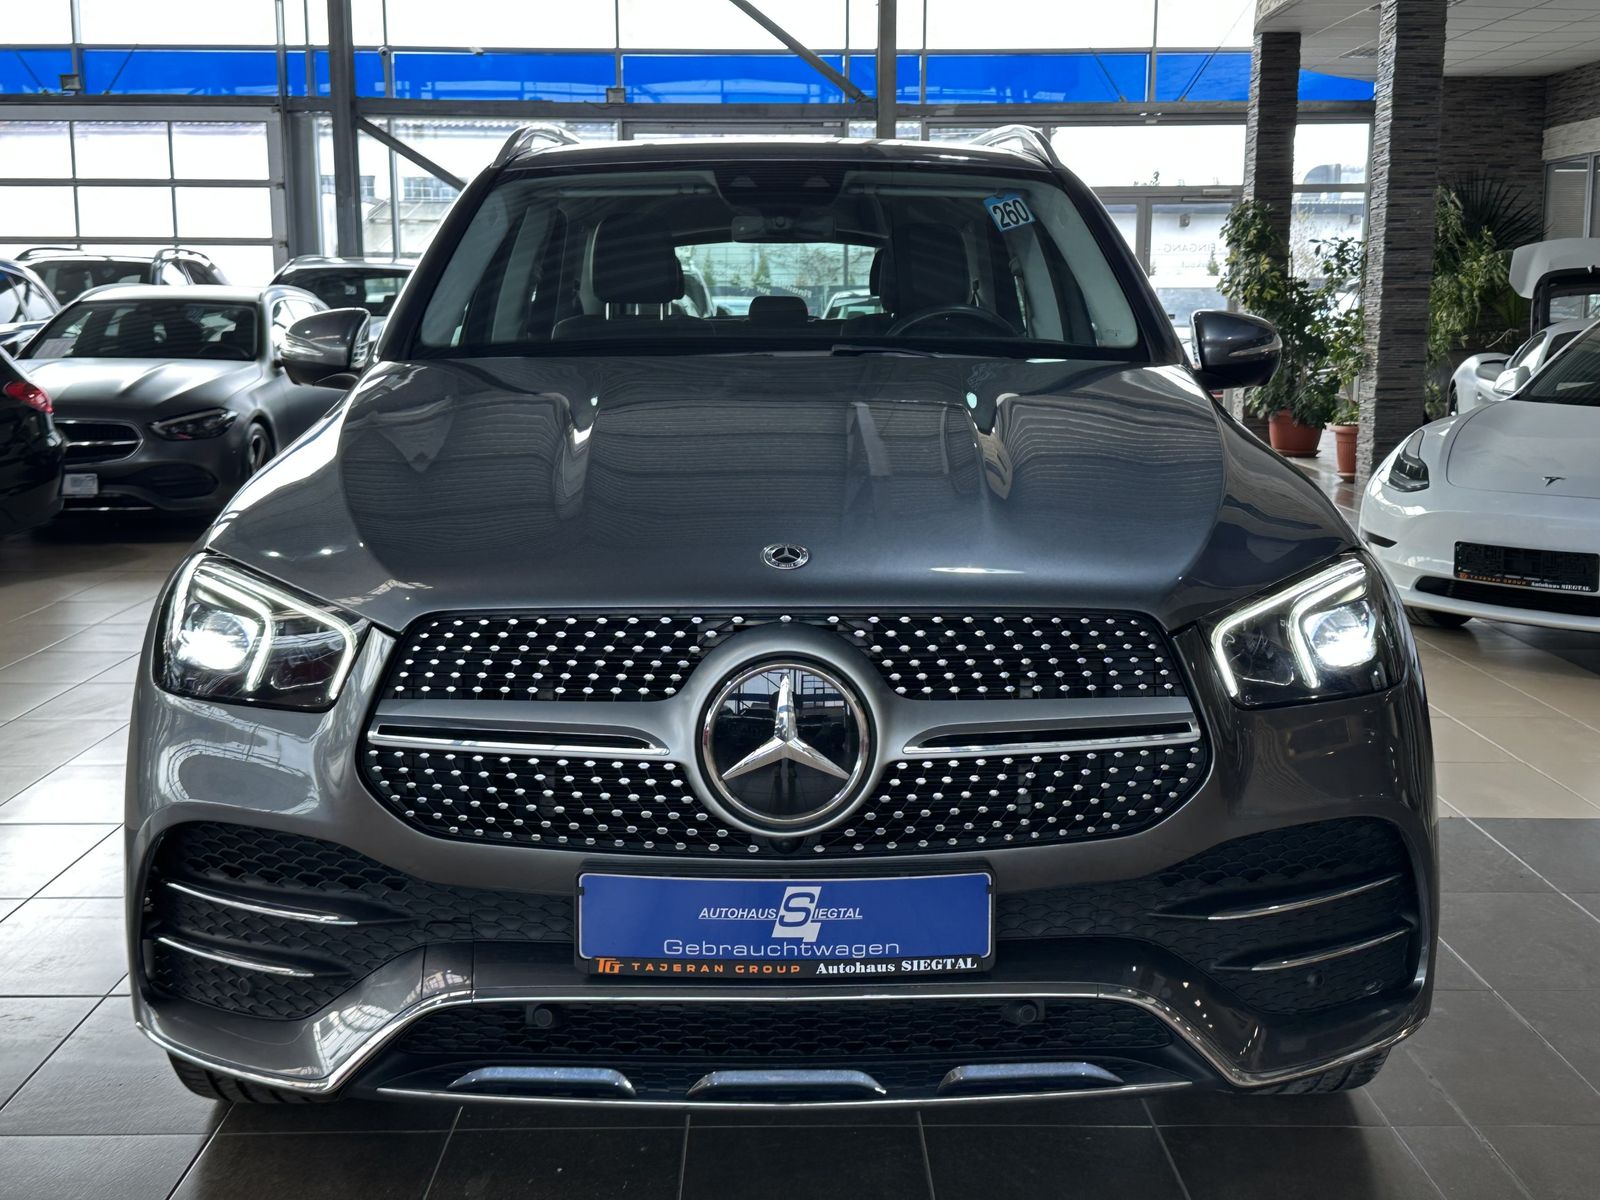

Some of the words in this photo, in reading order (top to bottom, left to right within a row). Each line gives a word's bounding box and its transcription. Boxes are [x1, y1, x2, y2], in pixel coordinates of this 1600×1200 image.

[992, 199, 1030, 228] 260
[699, 907, 777, 919] AUTOHAUS
[664, 939, 900, 958] Gebrauchtwagen
[595, 957, 624, 974] TG
[631, 962, 724, 973] TAJERAN
[735, 964, 800, 974] GROUP
[816, 962, 896, 974] Autohaus
[901, 957, 977, 971] SIEGTAL
